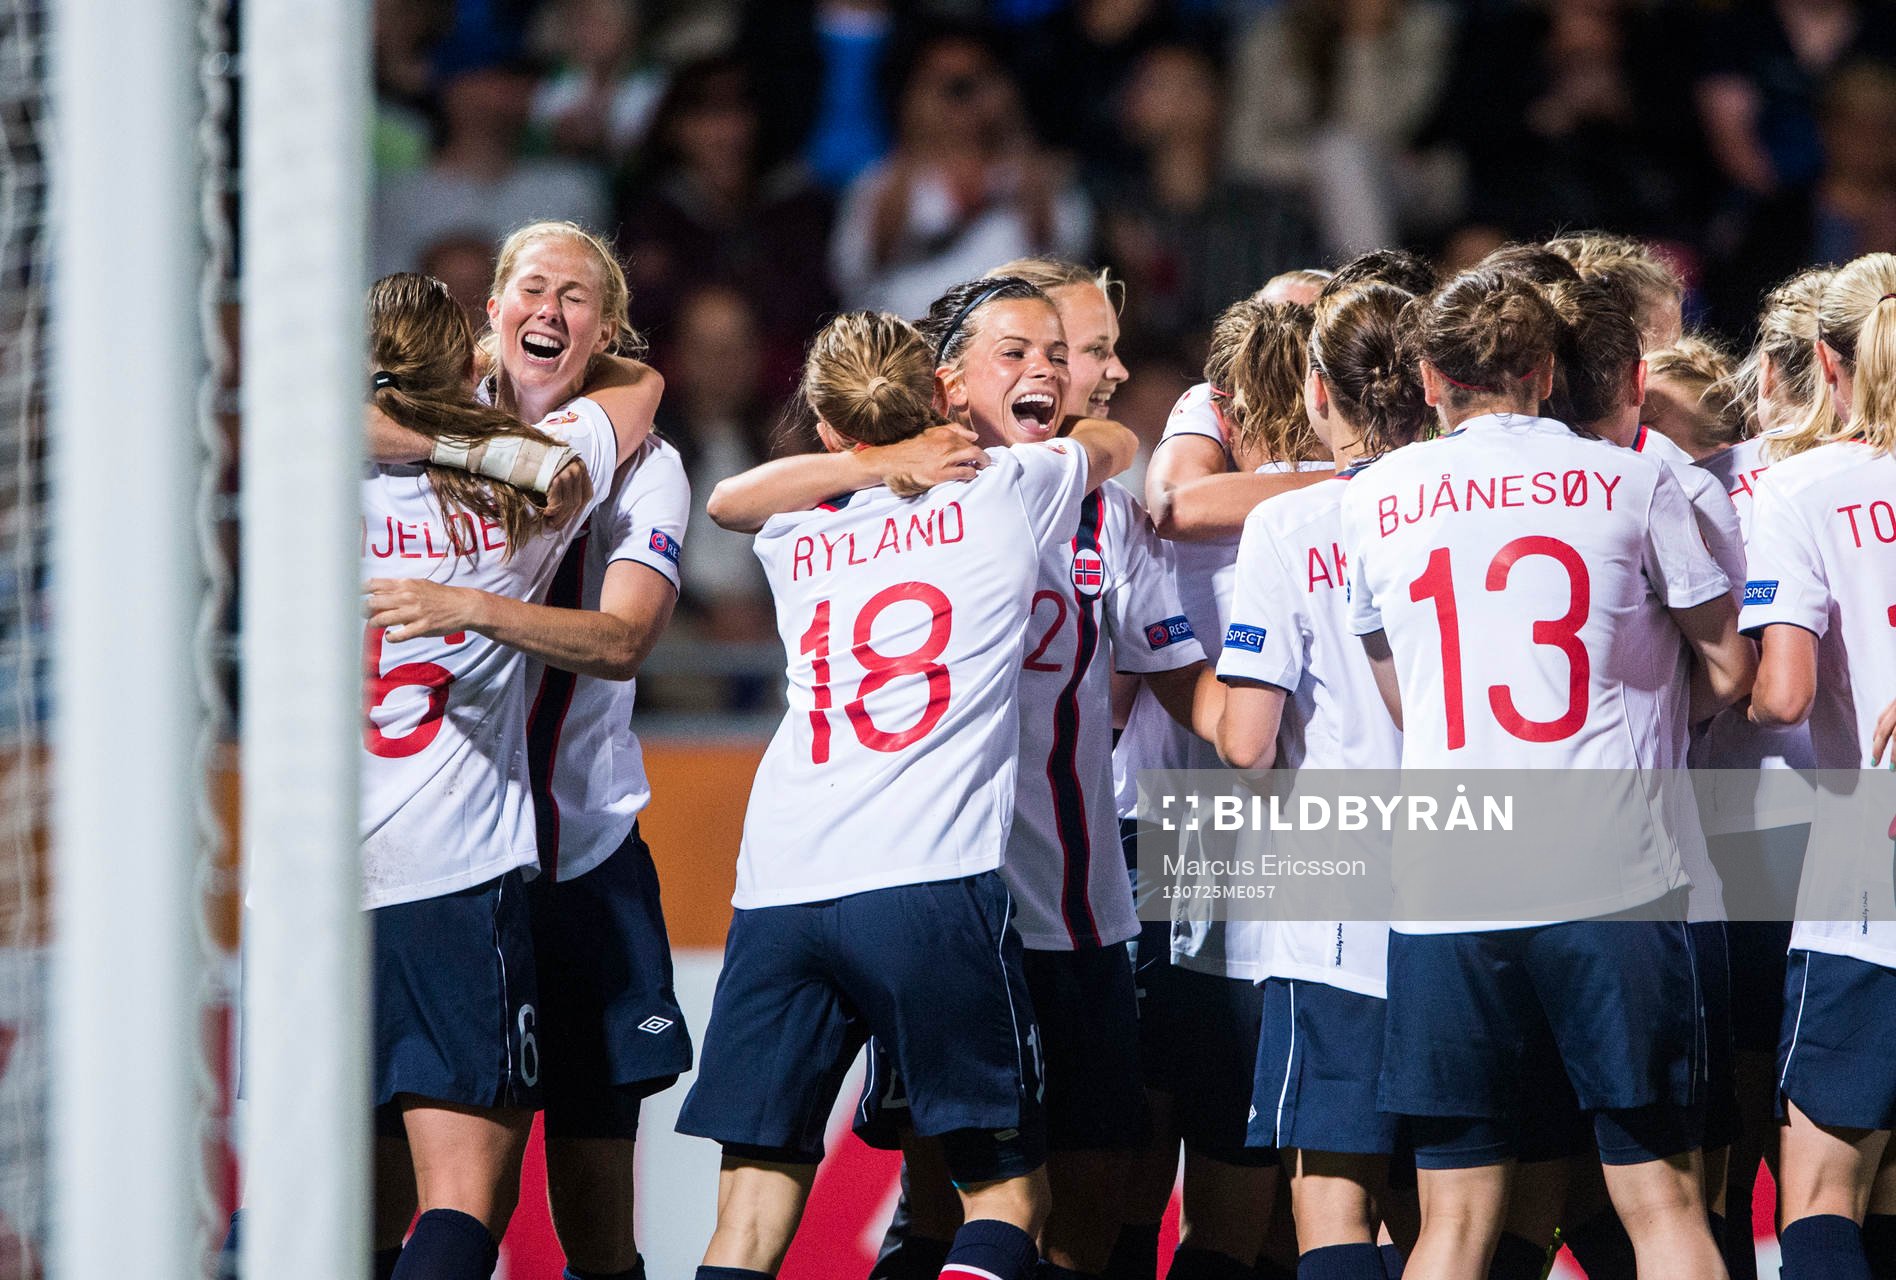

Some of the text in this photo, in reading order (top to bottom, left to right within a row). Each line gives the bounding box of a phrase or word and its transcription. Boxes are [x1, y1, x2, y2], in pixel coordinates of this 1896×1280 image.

[793, 501, 964, 581] RYLAND
[1379, 470, 1621, 538] BJÅNESØY
[667, 543, 680, 559] RE
[1022, 589, 1068, 672] 2
[1168, 621, 1193, 636] RESP
[1409, 536, 1590, 750] 13
[800, 581, 952, 765] 18
[518, 1003, 538, 1087] 6
